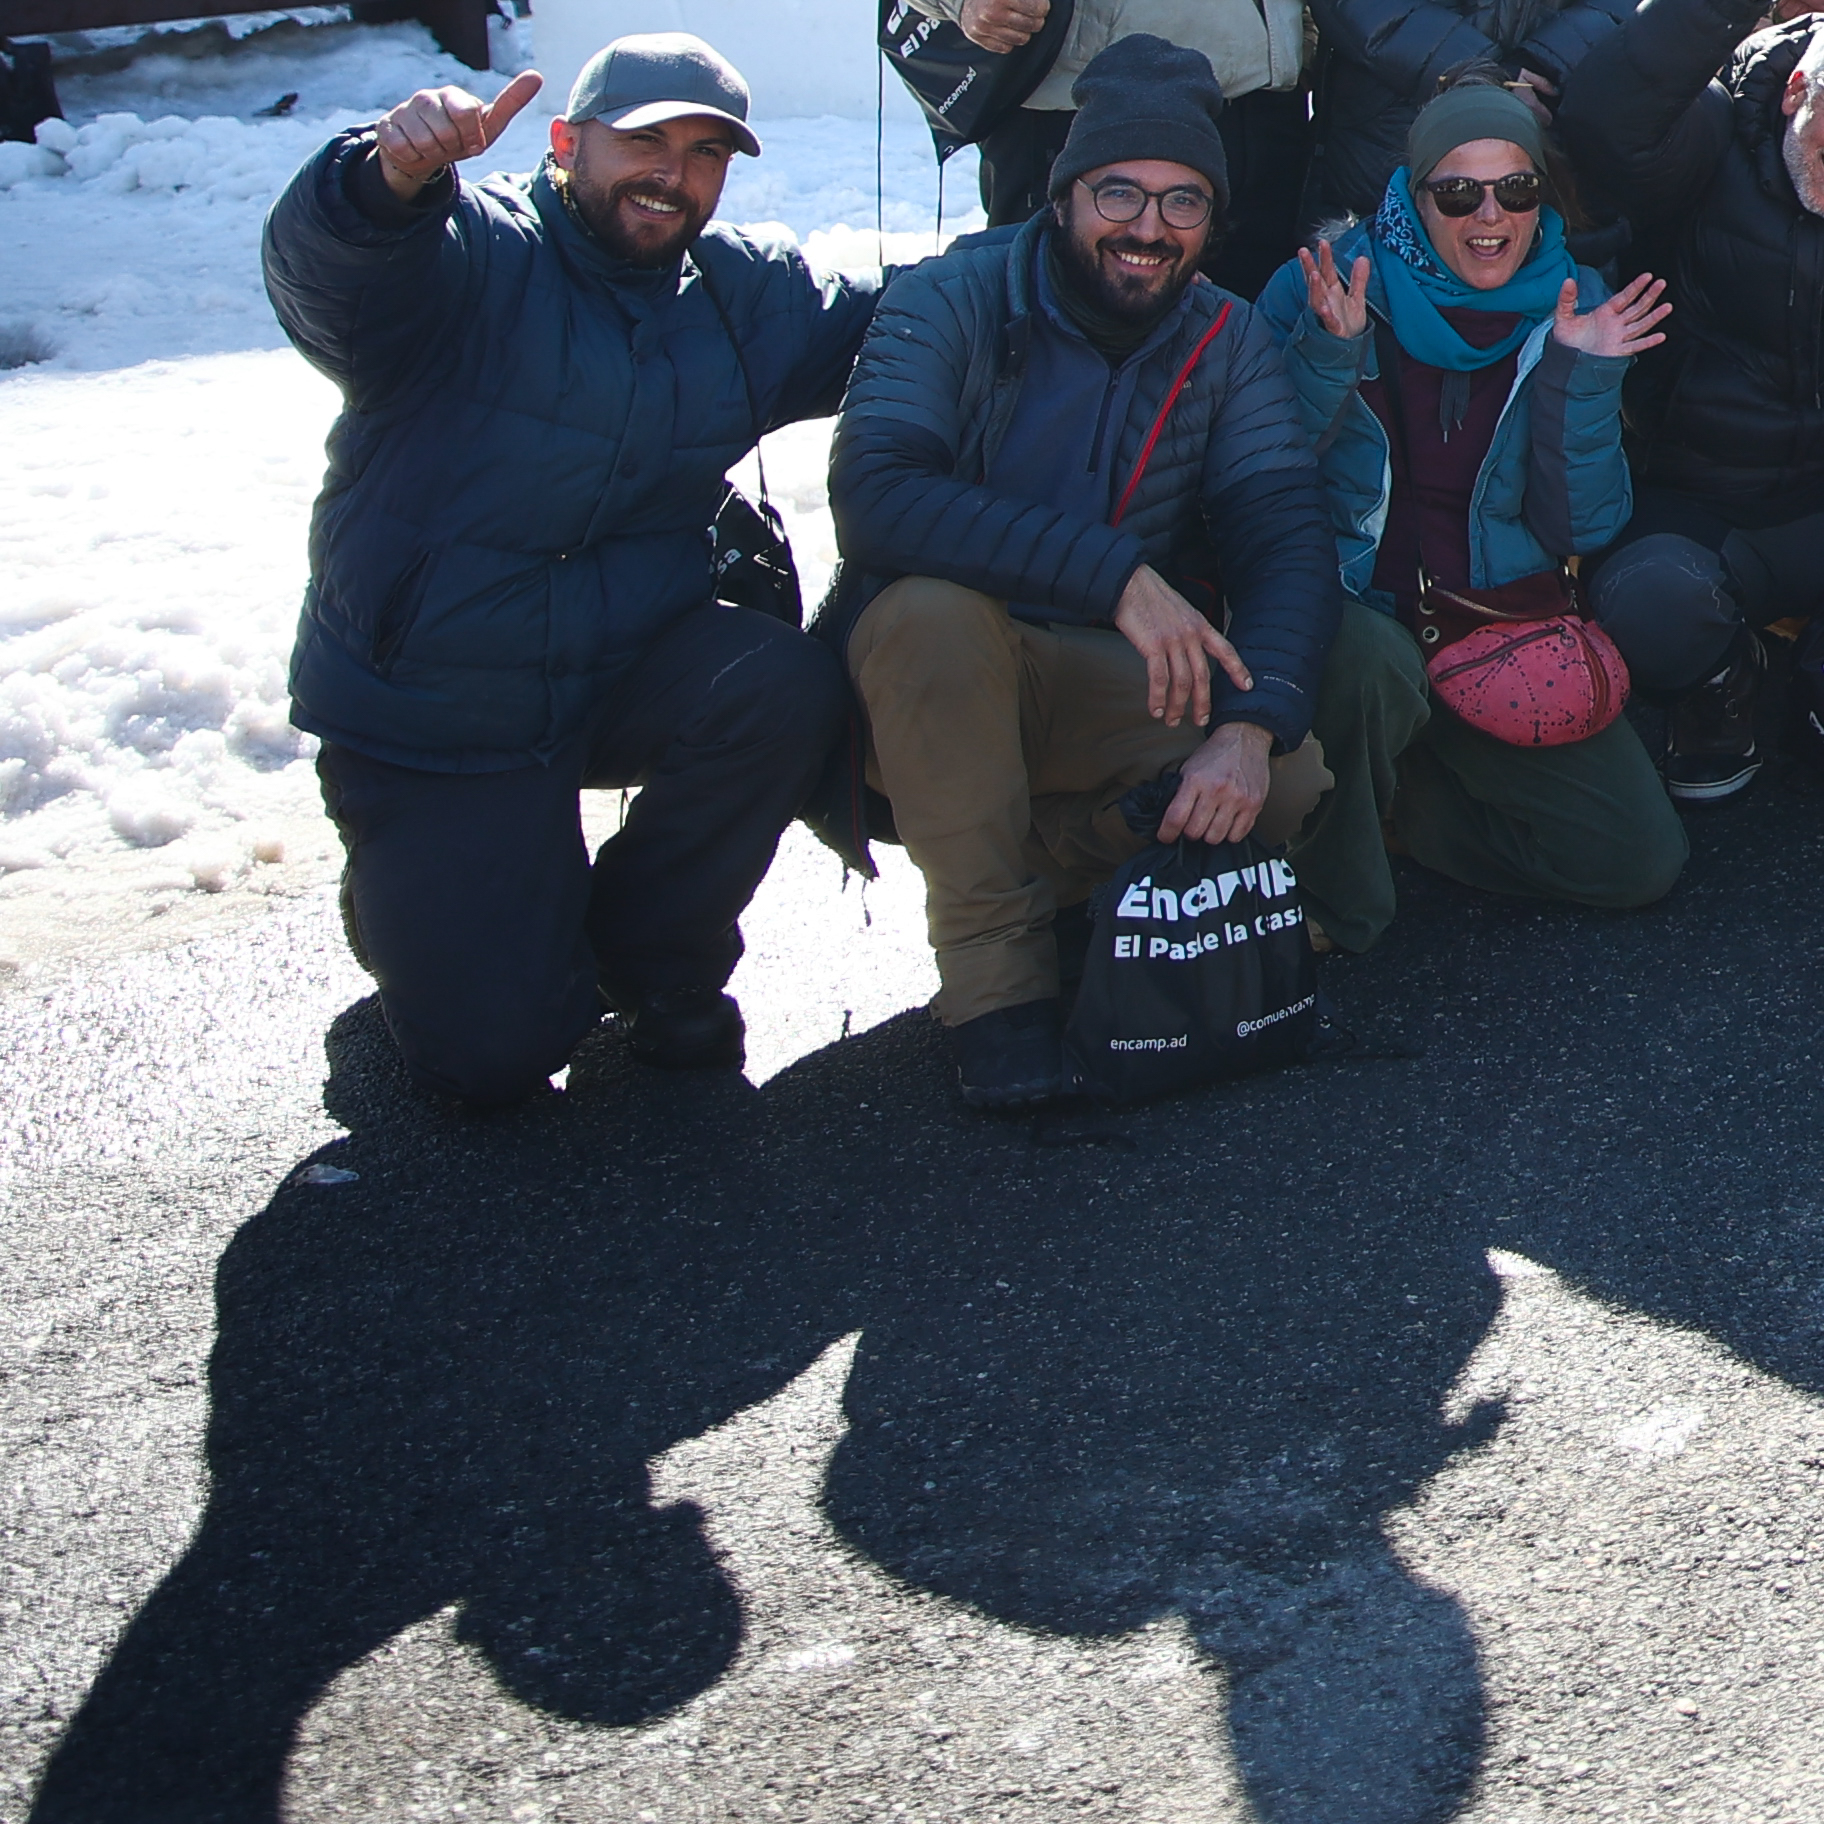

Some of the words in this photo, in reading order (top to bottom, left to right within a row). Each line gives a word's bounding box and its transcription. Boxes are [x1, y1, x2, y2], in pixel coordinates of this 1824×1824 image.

[900, 32, 921, 58] El
[938, 65, 977, 115] encamp.ad
[1114, 934, 1142, 958] El
[1223, 921, 1248, 946] la
[1236, 993, 1317, 1038] @comuencamp
[1110, 1034, 1188, 1053] encamp.ad
